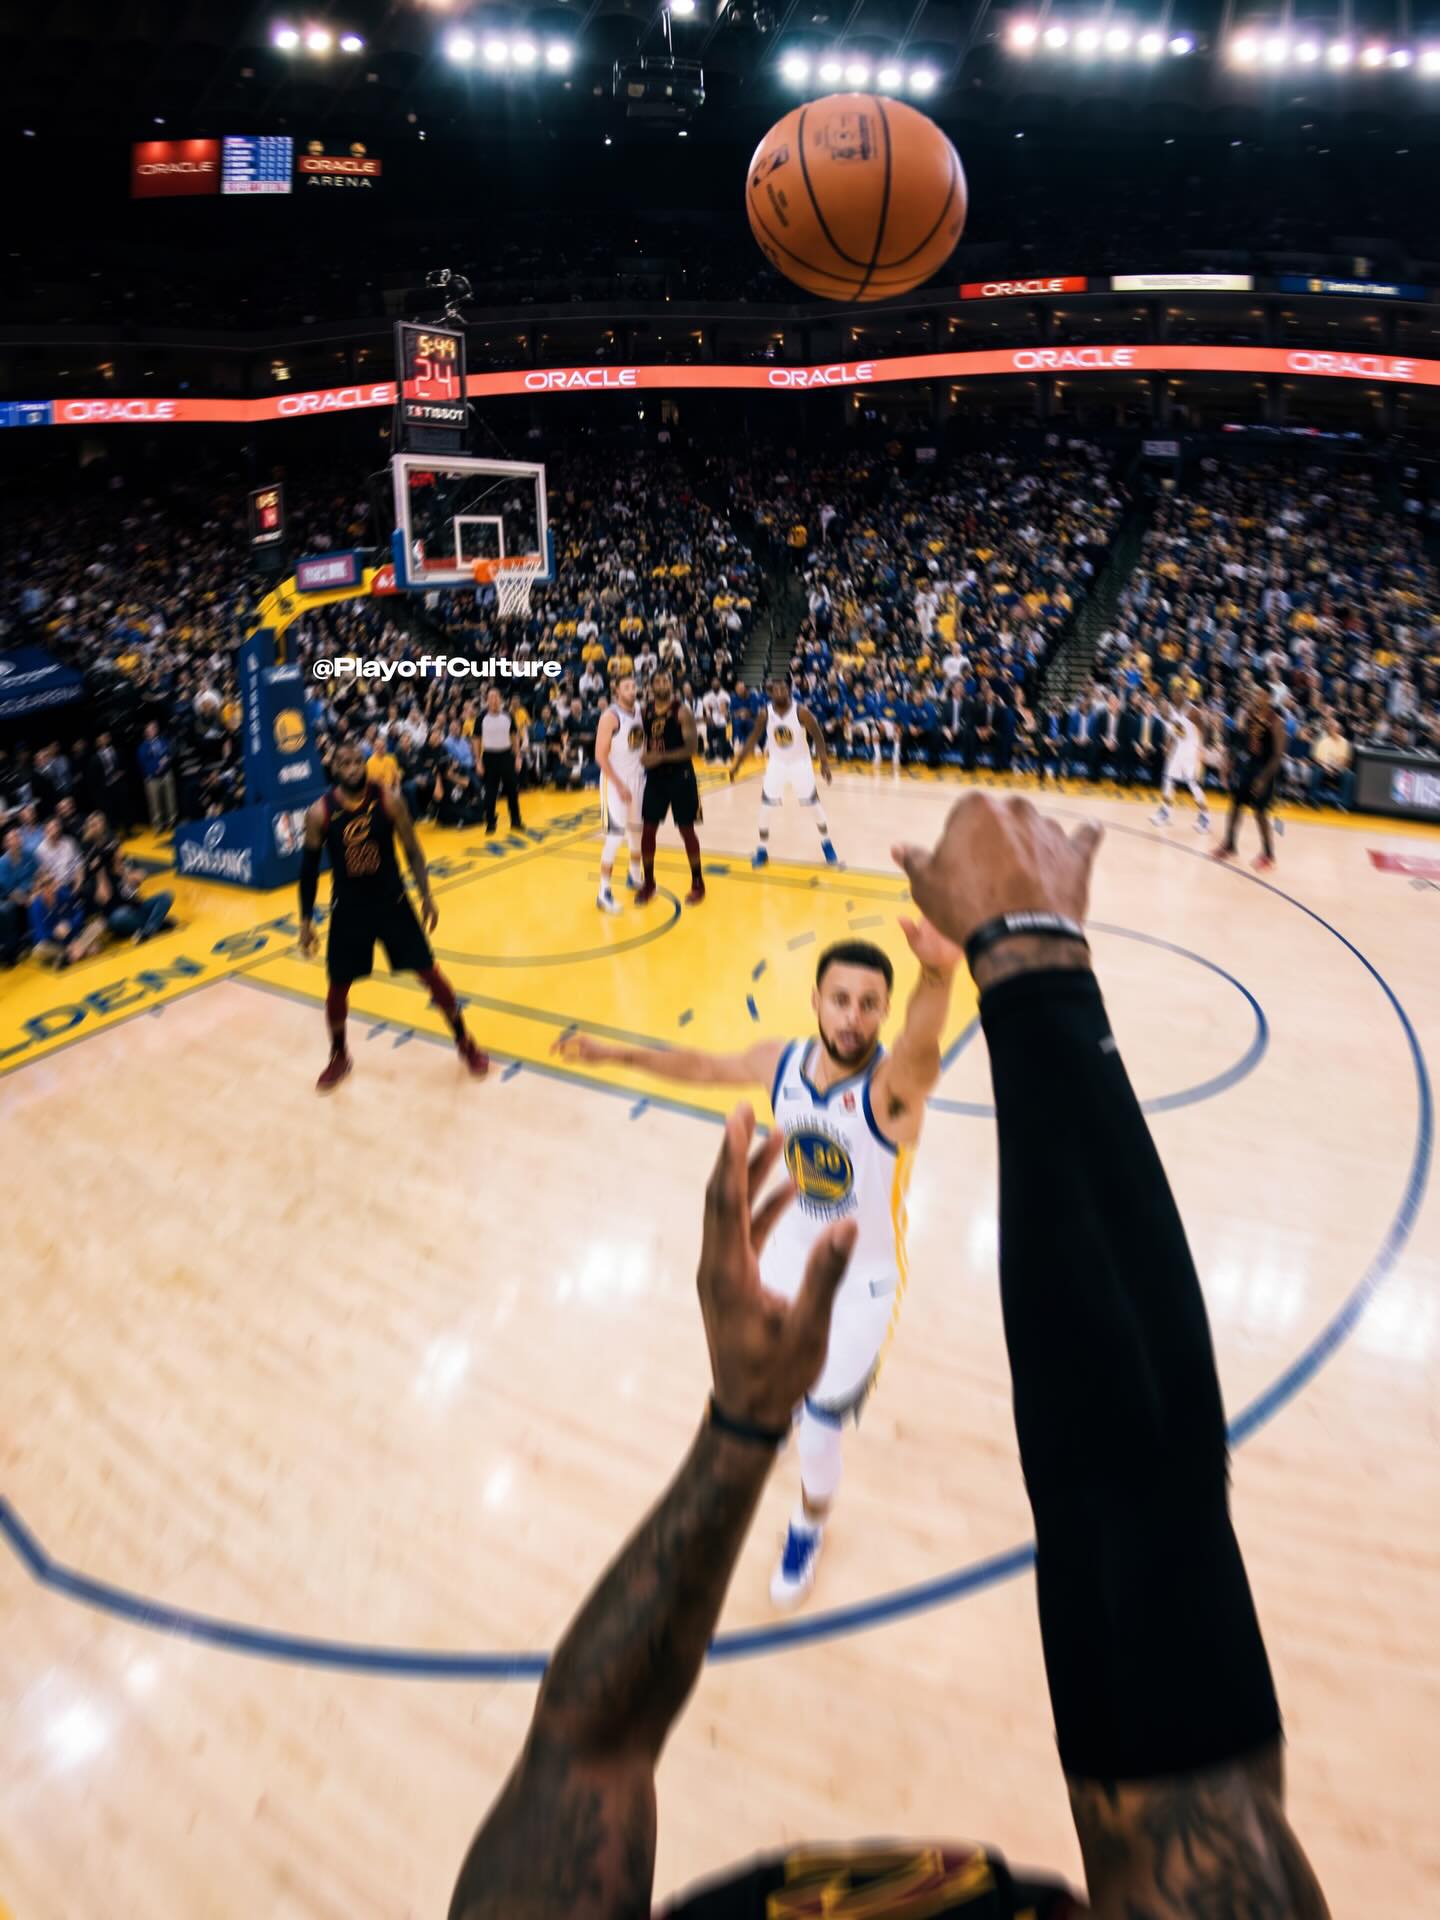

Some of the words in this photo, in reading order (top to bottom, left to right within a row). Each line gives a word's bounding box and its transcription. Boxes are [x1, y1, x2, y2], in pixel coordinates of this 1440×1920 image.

[137, 161, 216, 175] ORACLE
[304, 159, 376, 173] ORACLE
[307, 176, 372, 187] ARENA
[980, 279, 1064, 296] ORACLE
[1013, 349, 1134, 368] ORACLE
[1288, 352, 1415, 379] ORACLE
[415, 358, 452, 398] 24
[524, 369, 638, 389] ORACLE
[768, 364, 874, 386] ORACLE
[278, 386, 390, 414] ORACLE
[65, 402, 176, 420] ORACLE
